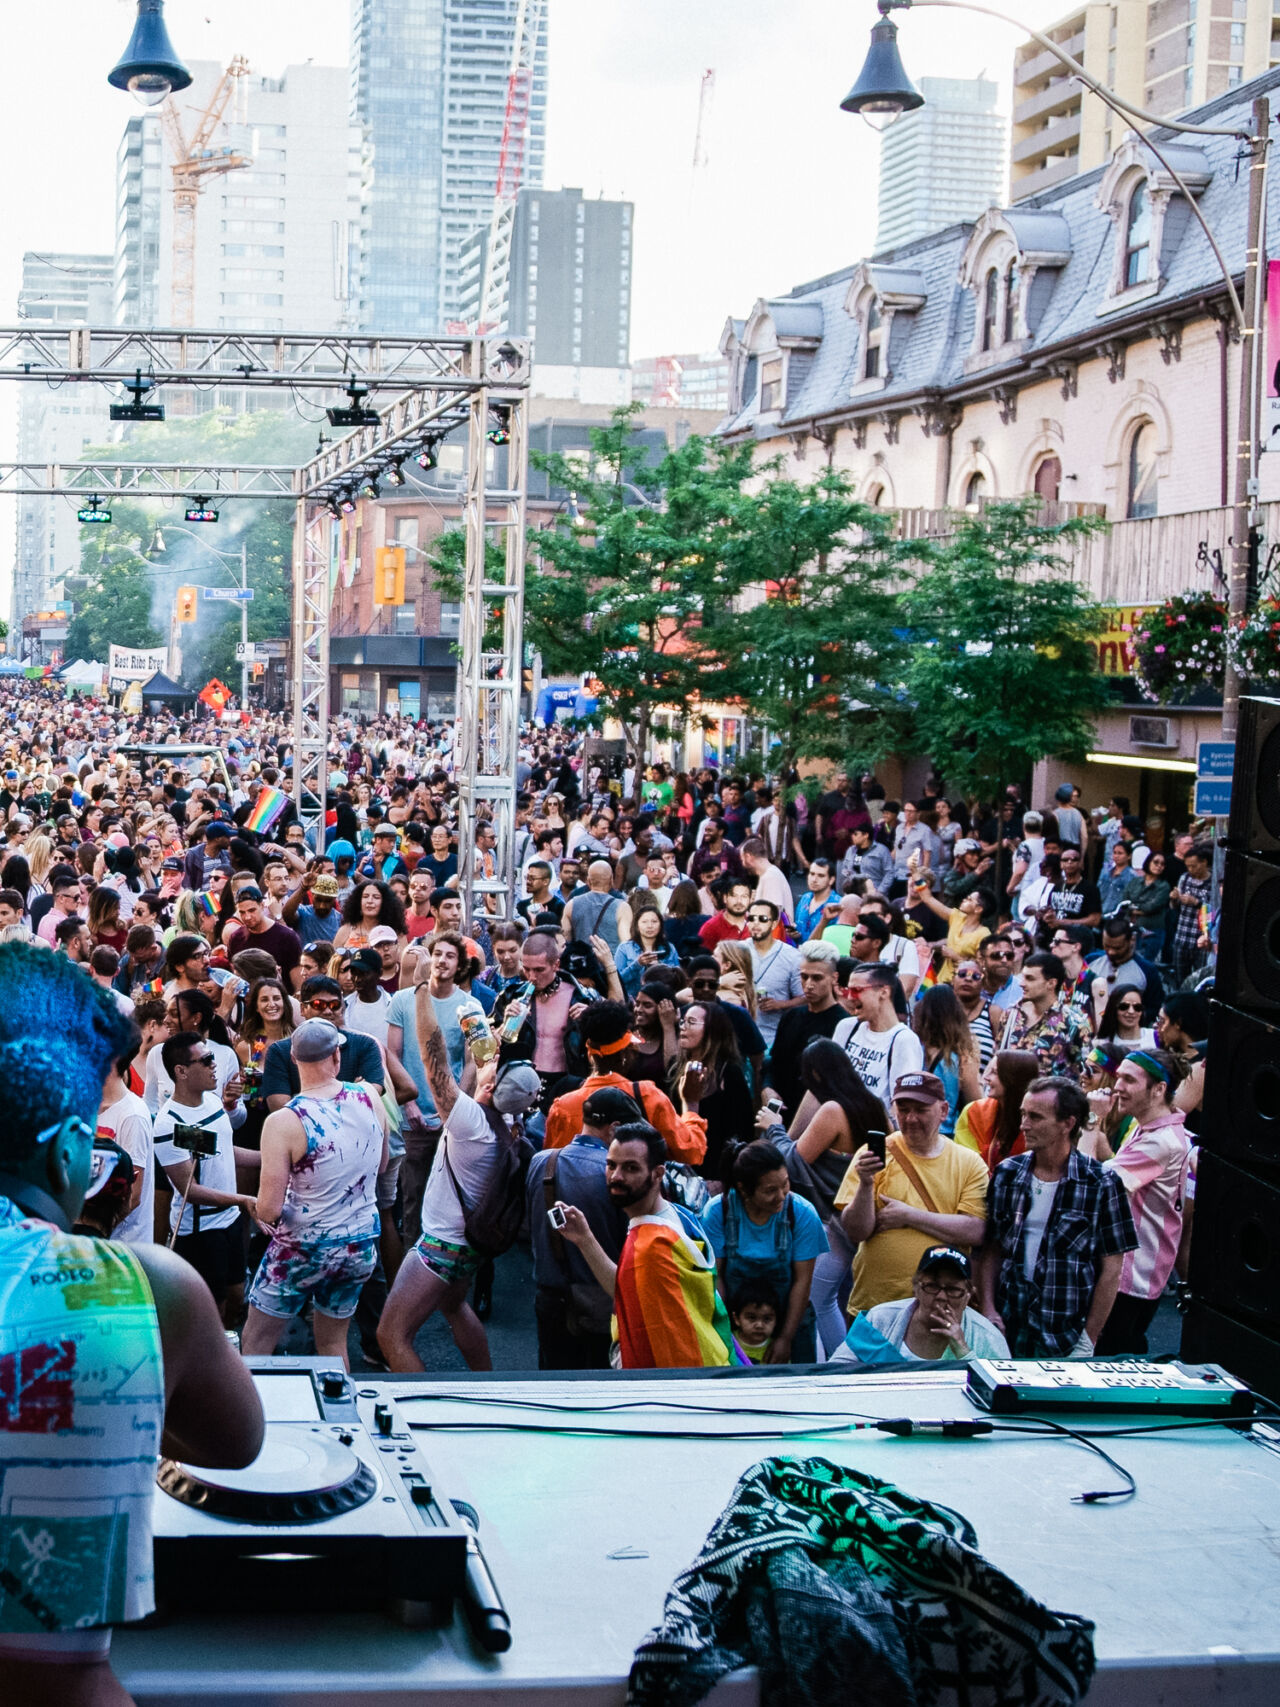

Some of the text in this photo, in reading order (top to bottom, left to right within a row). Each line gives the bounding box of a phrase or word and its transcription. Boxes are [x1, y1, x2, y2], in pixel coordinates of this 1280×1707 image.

[114, 653, 164, 670] Best Ribs Ever
[858, 1047, 887, 1063] READY
